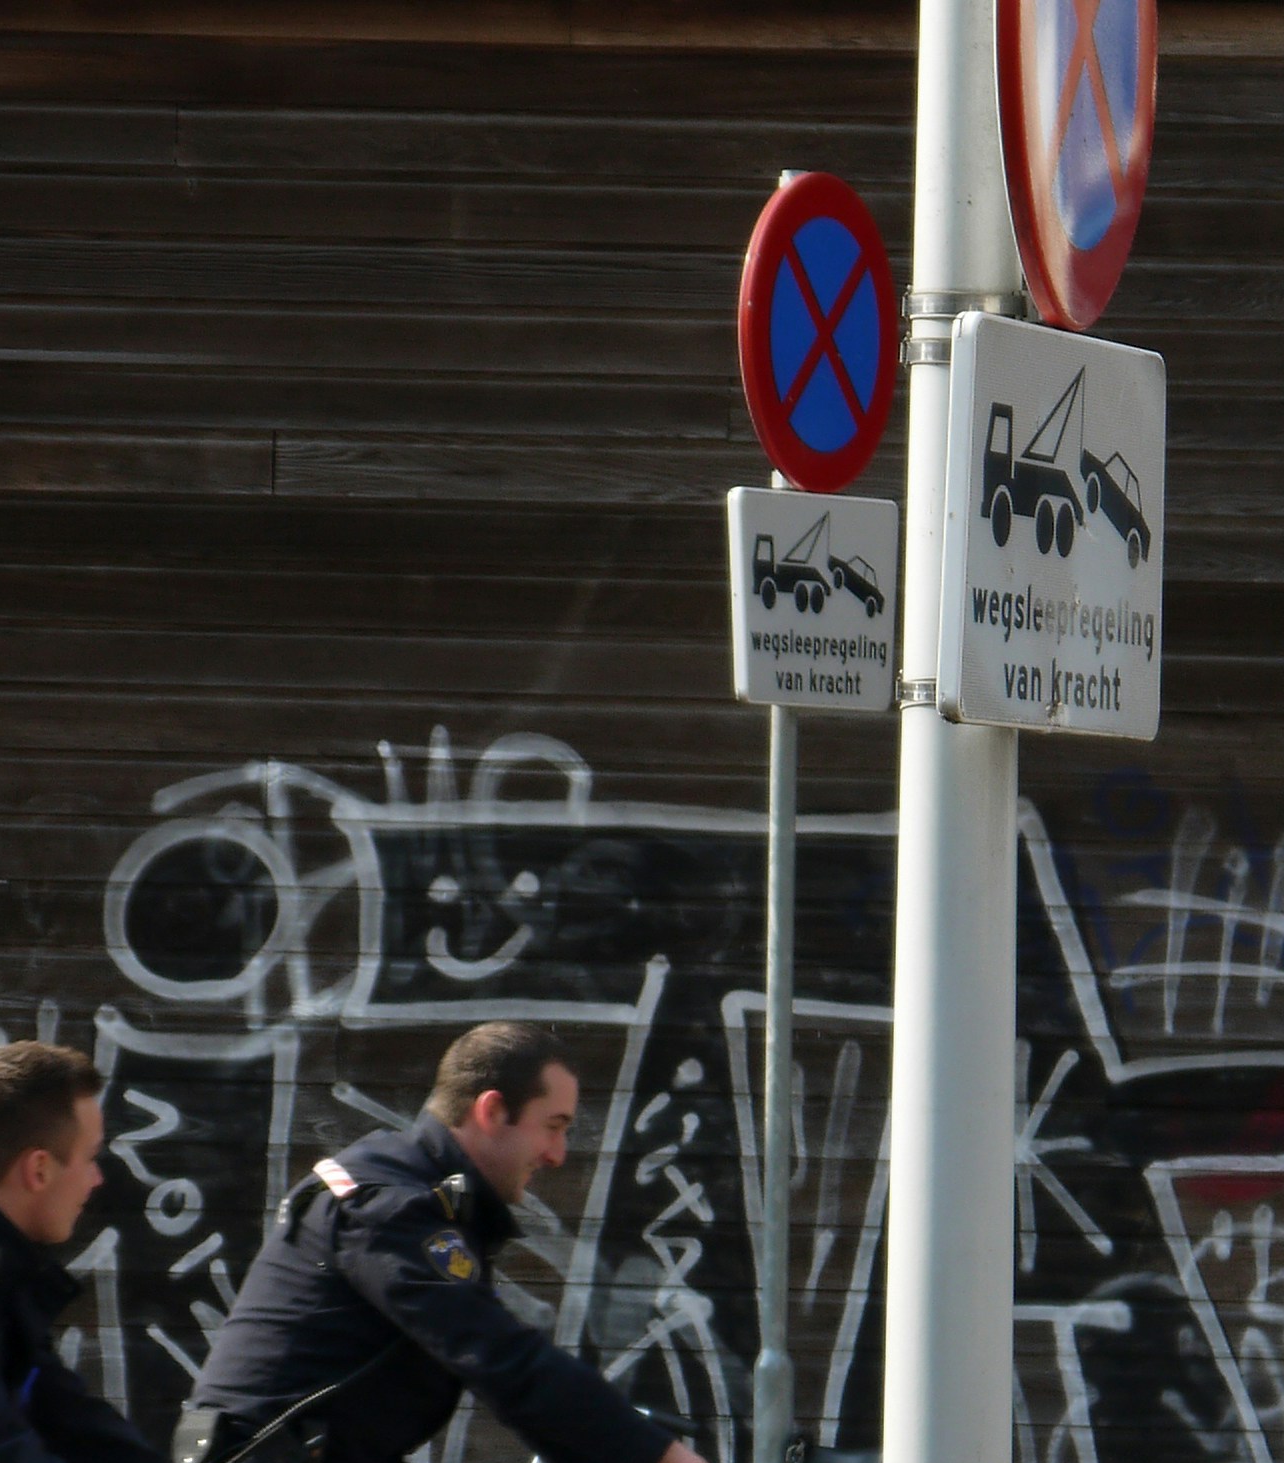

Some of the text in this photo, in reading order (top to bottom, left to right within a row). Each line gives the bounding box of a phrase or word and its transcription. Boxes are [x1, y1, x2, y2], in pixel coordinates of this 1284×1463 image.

[972, 583, 1156, 662] wegsleepregeling
[751, 628, 888, 667] wegsleepregeling
[775, 667, 862, 695] van kracht
[1003, 657, 1122, 712] van kracht
